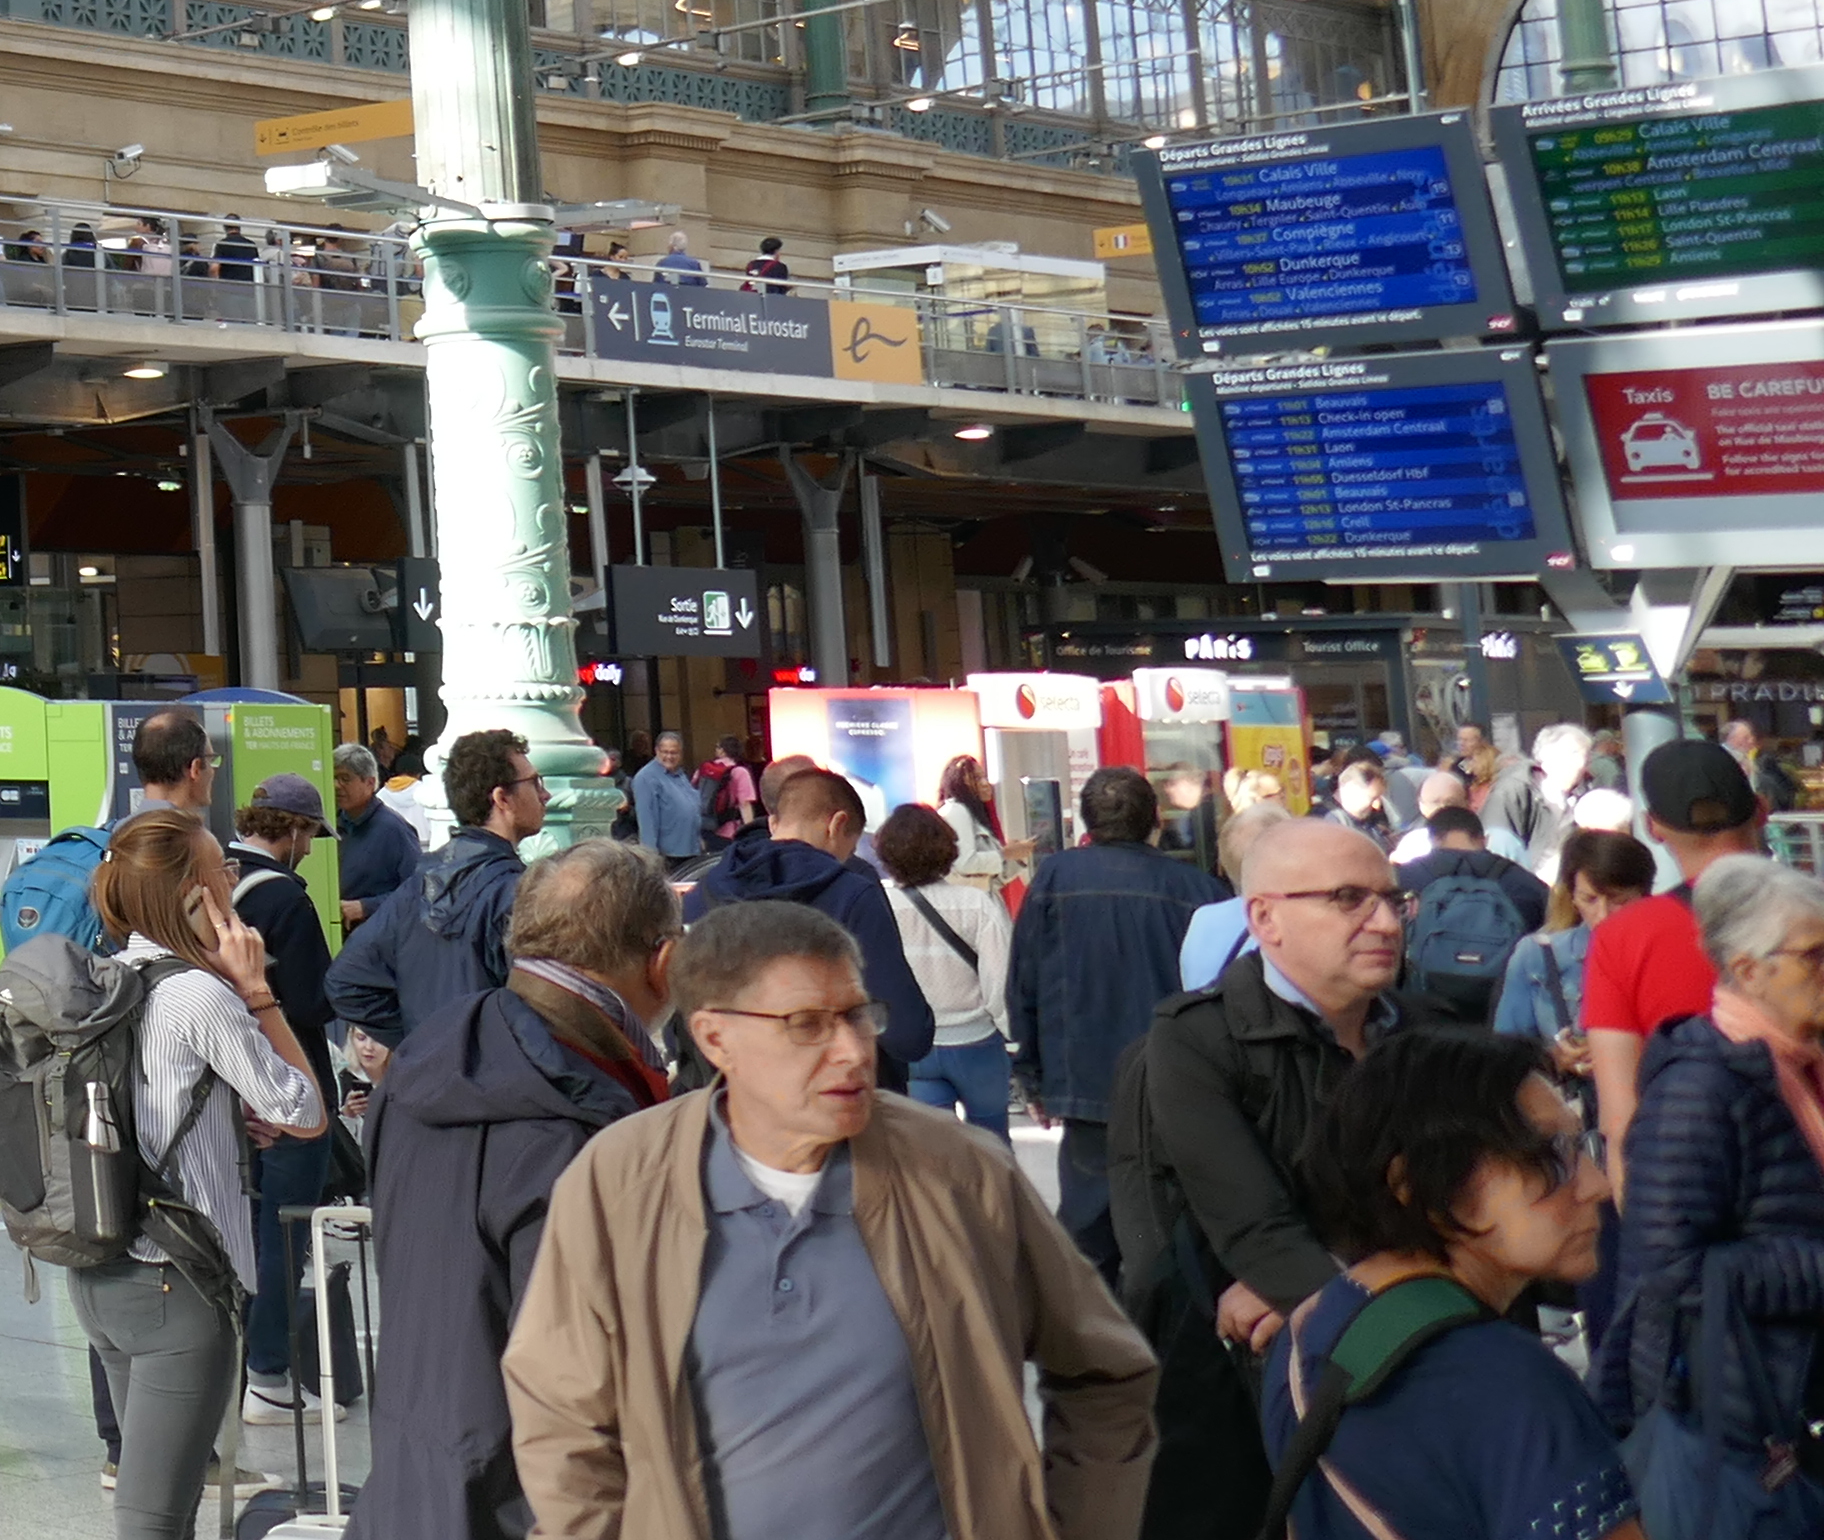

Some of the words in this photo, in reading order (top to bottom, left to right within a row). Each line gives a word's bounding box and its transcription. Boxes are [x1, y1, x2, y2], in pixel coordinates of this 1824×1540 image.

[1522, 101, 1581, 118] Arrivées
[1583, 91, 1642, 109] Grandes
[1647, 83, 1697, 102] Lignes
[292, 124, 323, 137] Contrôle
[324, 123, 336, 132] des
[337, 119, 360, 130] billets
[1638, 120, 1690, 139] Calais
[1690, 116, 1730, 131] Ville
[1159, 146, 1209, 162] Départs
[1210, 140, 1262, 155] Grandes
[1264, 135, 1308, 150] Lignes
[1646, 149, 1744, 171] Amsterdam
[1748, 136, 1824, 158] Centraal
[1259, 167, 1302, 182] Calais
[1303, 162, 1337, 177] Ville
[1625, 170, 1682, 187] Centraal
[1653, 187, 1687, 201] Laon
[1266, 194, 1341, 212] Maubeuge
[1658, 203, 1686, 216] Lille
[1689, 196, 1749, 214] Flandres
[1251, 212, 1297, 228] Tergnier
[1307, 203, 1391, 222] Saint-Quentin
[1661, 218, 1714, 233] London
[1716, 208, 1792, 227] St-Pancras
[1273, 223, 1354, 242] Compiègne
[1665, 228, 1764, 248] Saint-Quentin
[1280, 253, 1360, 272] Dunkerque
[1669, 248, 1722, 264] Amiens
[1214, 278, 1244, 291] Arras
[1252, 274, 1276, 287] Lille
[1279, 271, 1320, 286] Europe
[1329, 264, 1395, 281] Dunkerque
[1285, 282, 1383, 301] Valenciennes
[1303, 297, 1381, 313] Valenciennes
[682, 306, 748, 334] Terminal
[749, 313, 810, 340] Eurostar
[685, 335, 717, 350] Eurostar
[717, 338, 749, 353] Terminal
[1212, 369, 1264, 385] Départs
[1266, 364, 1320, 381] Grandes
[1321, 361, 1366, 378] Lignes
[1622, 387, 1675, 405] Taxis
[1707, 382, 1734, 400] BE
[1738, 377, 1824, 399] CAREFU
[1315, 395, 1368, 409] Beauvais
[1318, 411, 1371, 425] Check-in
[1373, 410, 1405, 423] open
[1322, 423, 1391, 439] Amsterdam
[1393, 420, 1447, 436] Centraal
[1715, 423, 1736, 435] The
[1737, 422, 1774, 434] official
[1775, 422, 1796, 433] taxi
[1324, 443, 1356, 454] Laon
[1718, 437, 1732, 447] on
[1734, 435, 1756, 446] Rue
[1328, 455, 1374, 469] Amiens
[1722, 453, 1759, 465] Follow
[1760, 451, 1779, 463] the
[1331, 467, 1402, 484] Duesseldorf
[1405, 466, 1430, 479] Hbf
[1724, 465, 1741, 476] for
[1334, 484, 1388, 499] Beauvais
[1337, 500, 1384, 514] London
[1385, 498, 1452, 512] St-Pancras
[1341, 516, 1371, 529] Creil
[1344, 530, 1412, 545] Dunkerque
[670, 597, 698, 613] Sortie
[1056, 645, 1087, 657] Office
[1088, 646, 1101, 656] de
[1104, 644, 1152, 657] Tourisme
[1302, 641, 1343, 654] Tourist
[1344, 640, 1380, 653] Office
[594, 663, 623, 686] daily
[1040, 695, 1082, 712] selecta
[1188, 688, 1221, 706] selecta
[243, 716, 275, 727] BILLETS
[244, 727, 251, 738] &
[252, 727, 315, 739] ABONNEMENTS
[120, 743, 133, 753] TER
[245, 741, 258, 750] TER
[258, 741, 315, 750] HAUTS-DE-FRANCE
